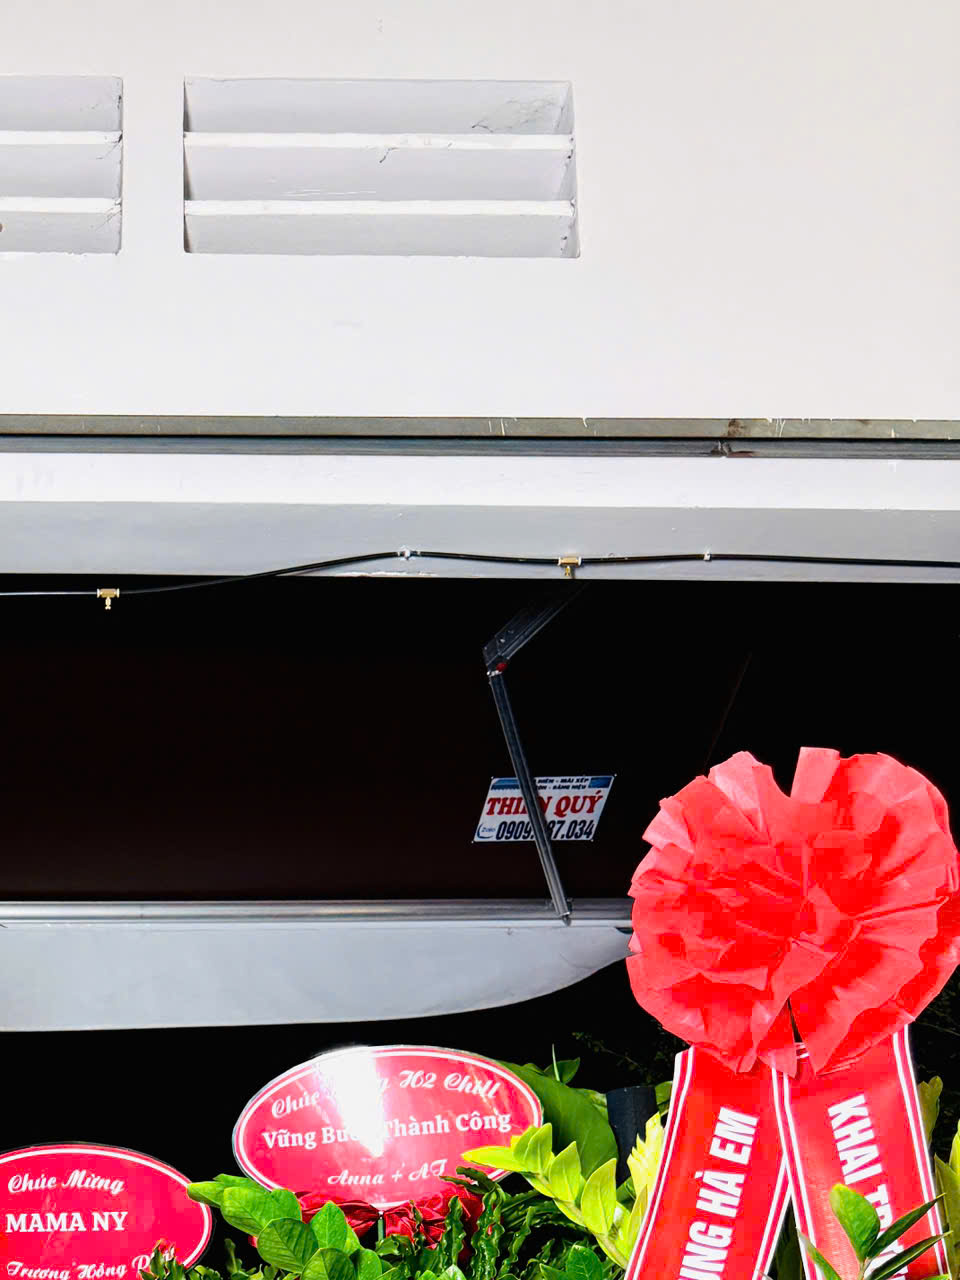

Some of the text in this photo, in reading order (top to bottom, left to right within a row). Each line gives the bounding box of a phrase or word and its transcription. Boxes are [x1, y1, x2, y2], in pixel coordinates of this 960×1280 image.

[486, 790, 604, 818] THIN QUÝ
[262, 1128, 318, 1150] Vững
[455, 1110, 512, 1133] Công
[709, 1106, 760, 1166] EM
[827, 1093, 884, 1186] KHAI
[7, 1168, 125, 1195] Chúc Mừng
[326, 1169, 385, 1185] Anna
[693, 1170, 746, 1218] HÀ
[5, 1211, 128, 1233] MAMA NY
